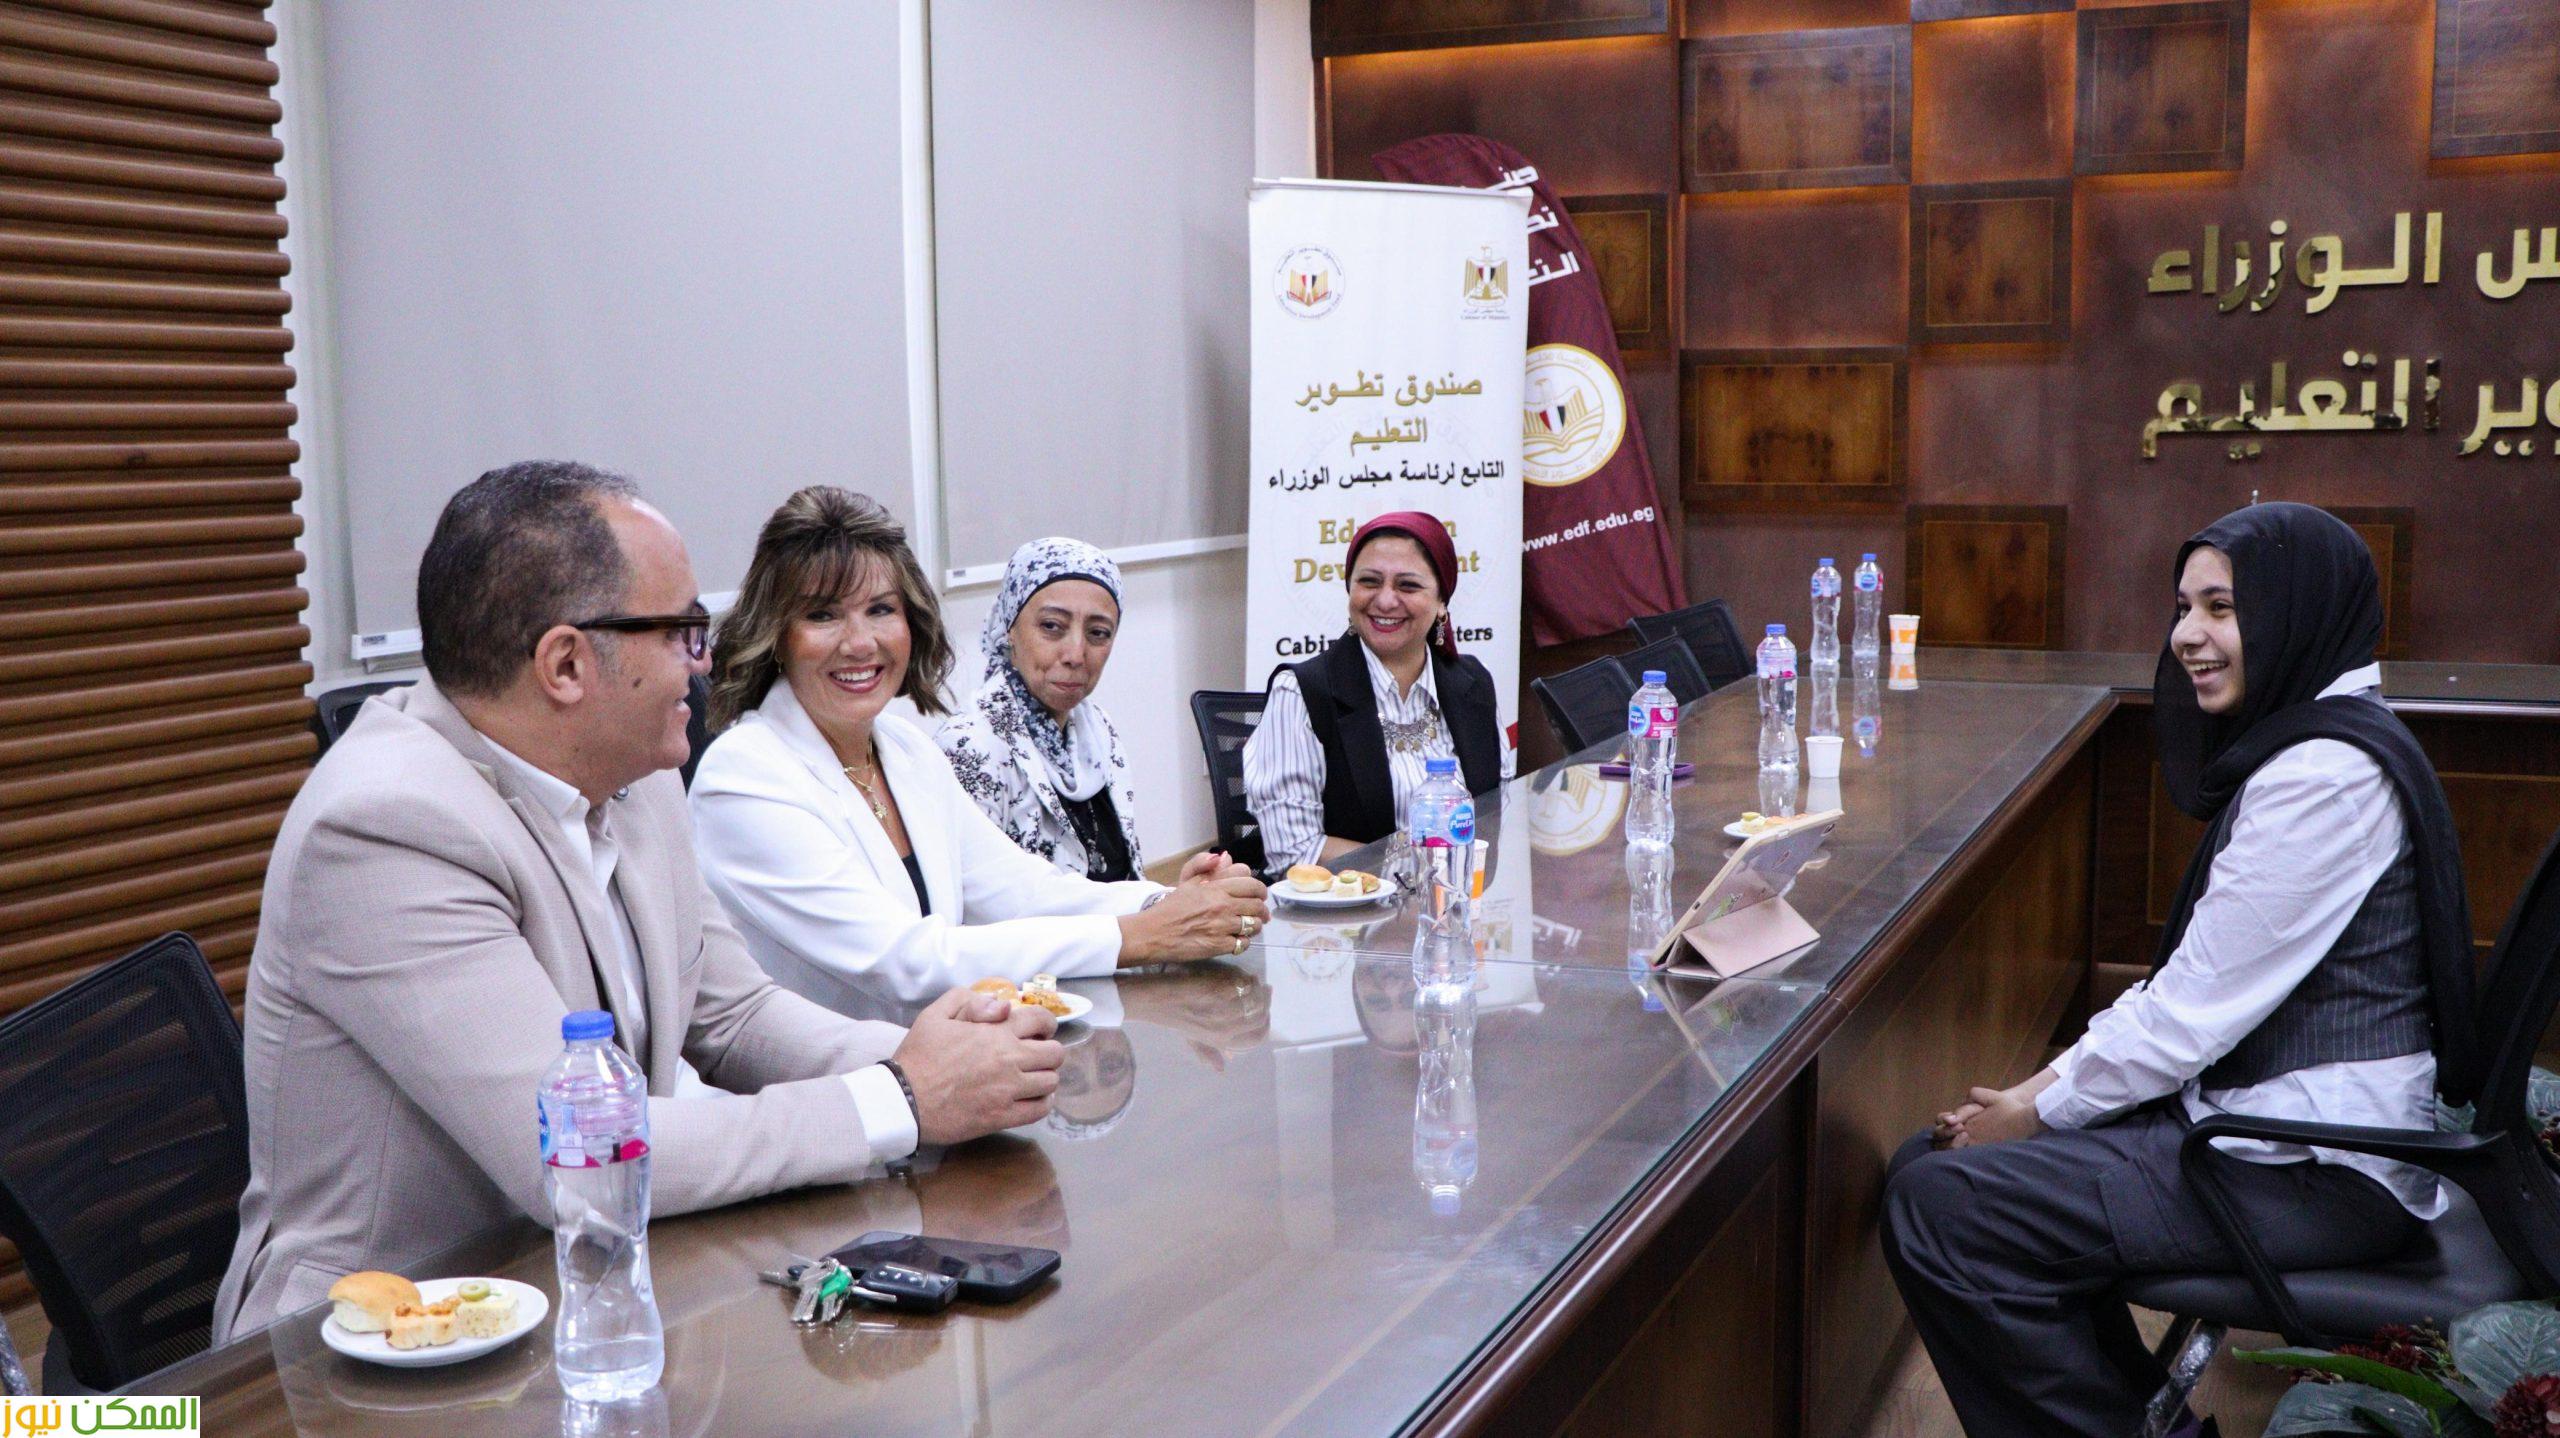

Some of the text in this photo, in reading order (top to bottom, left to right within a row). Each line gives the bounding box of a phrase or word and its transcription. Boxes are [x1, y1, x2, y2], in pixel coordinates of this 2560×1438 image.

[2148, 211, 2443, 314] الوزراء
[1296, 369, 1483, 412] صندوق تطوير
[2142, 350, 2441, 460] التعليم
[1350, 416, 1429, 457] التعليم
[1269, 459, 1505, 491] التابع لرئاسة مجلس الوزراء
